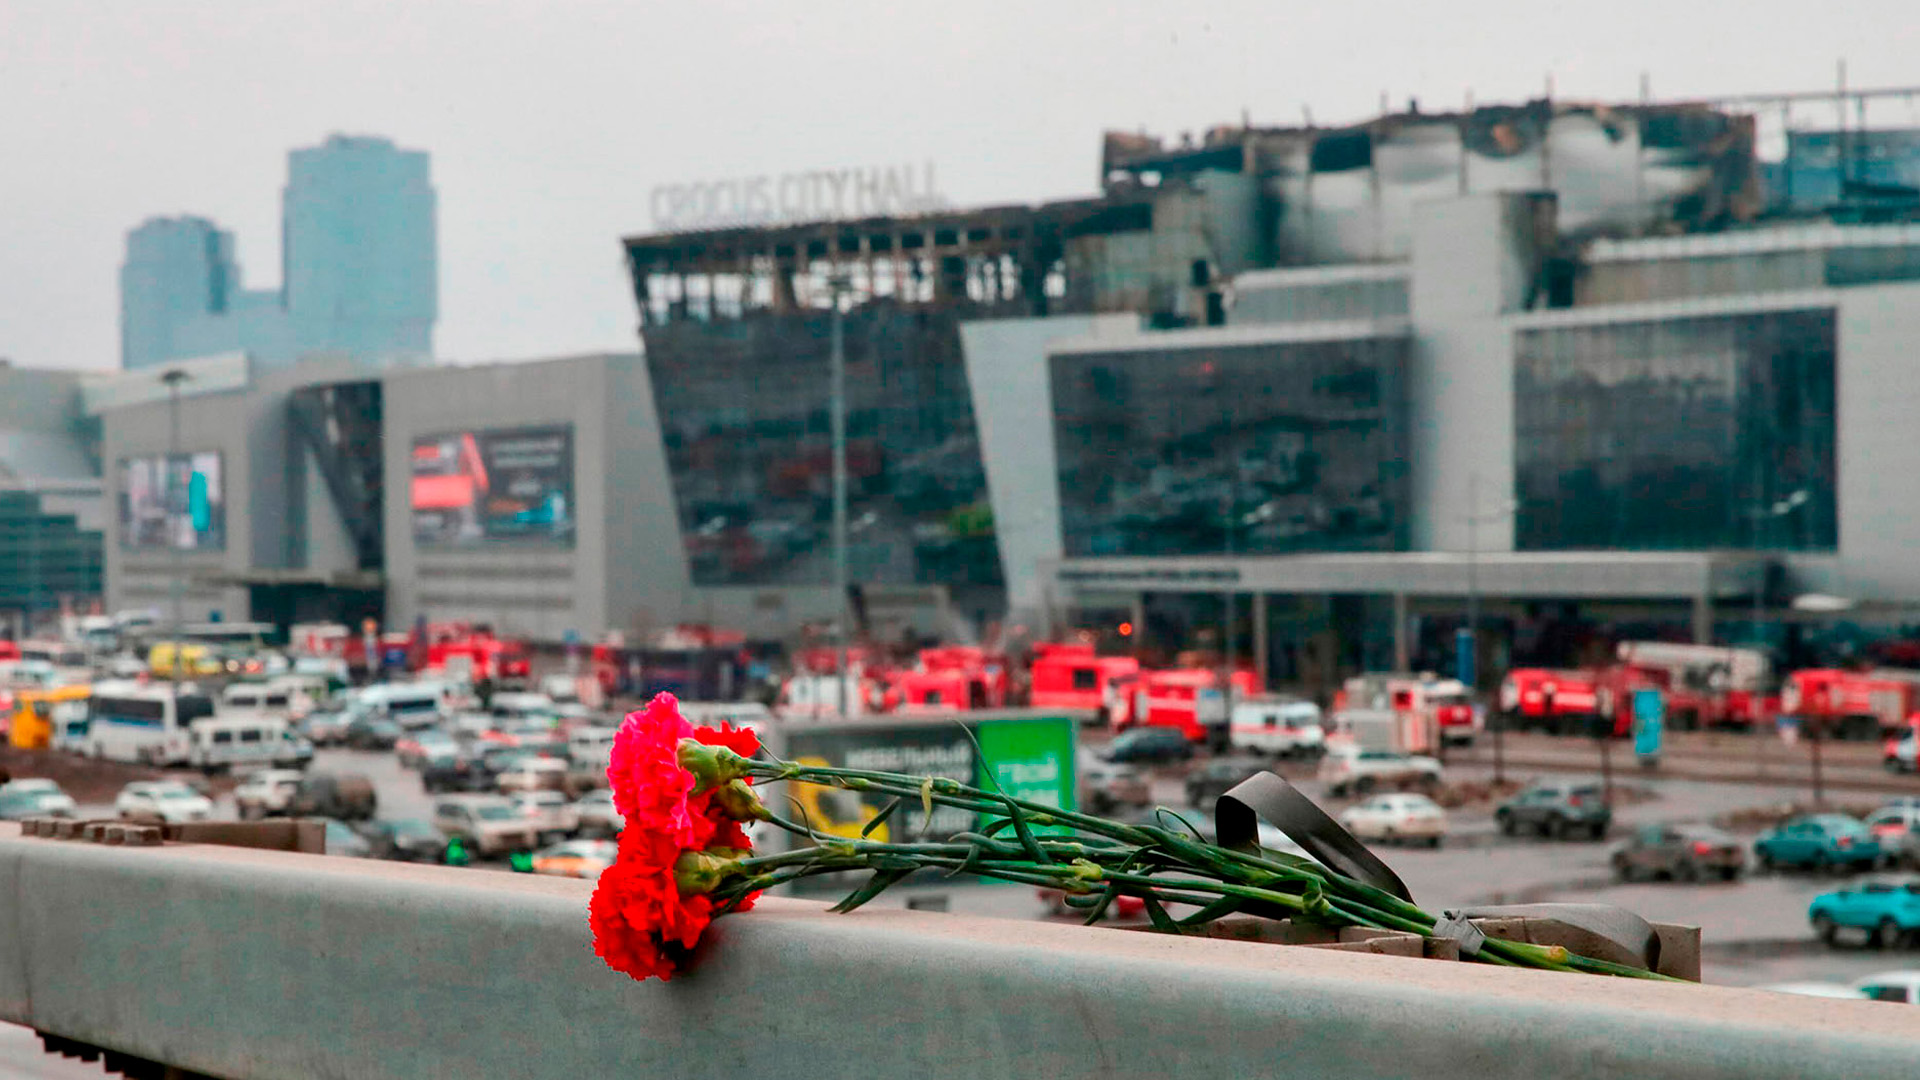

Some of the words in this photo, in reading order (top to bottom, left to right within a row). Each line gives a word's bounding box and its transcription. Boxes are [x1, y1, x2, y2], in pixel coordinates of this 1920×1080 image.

[650, 176, 771, 230] CROCUS
[777, 169, 850, 220] CITY
[853, 160, 948, 213] HALL
